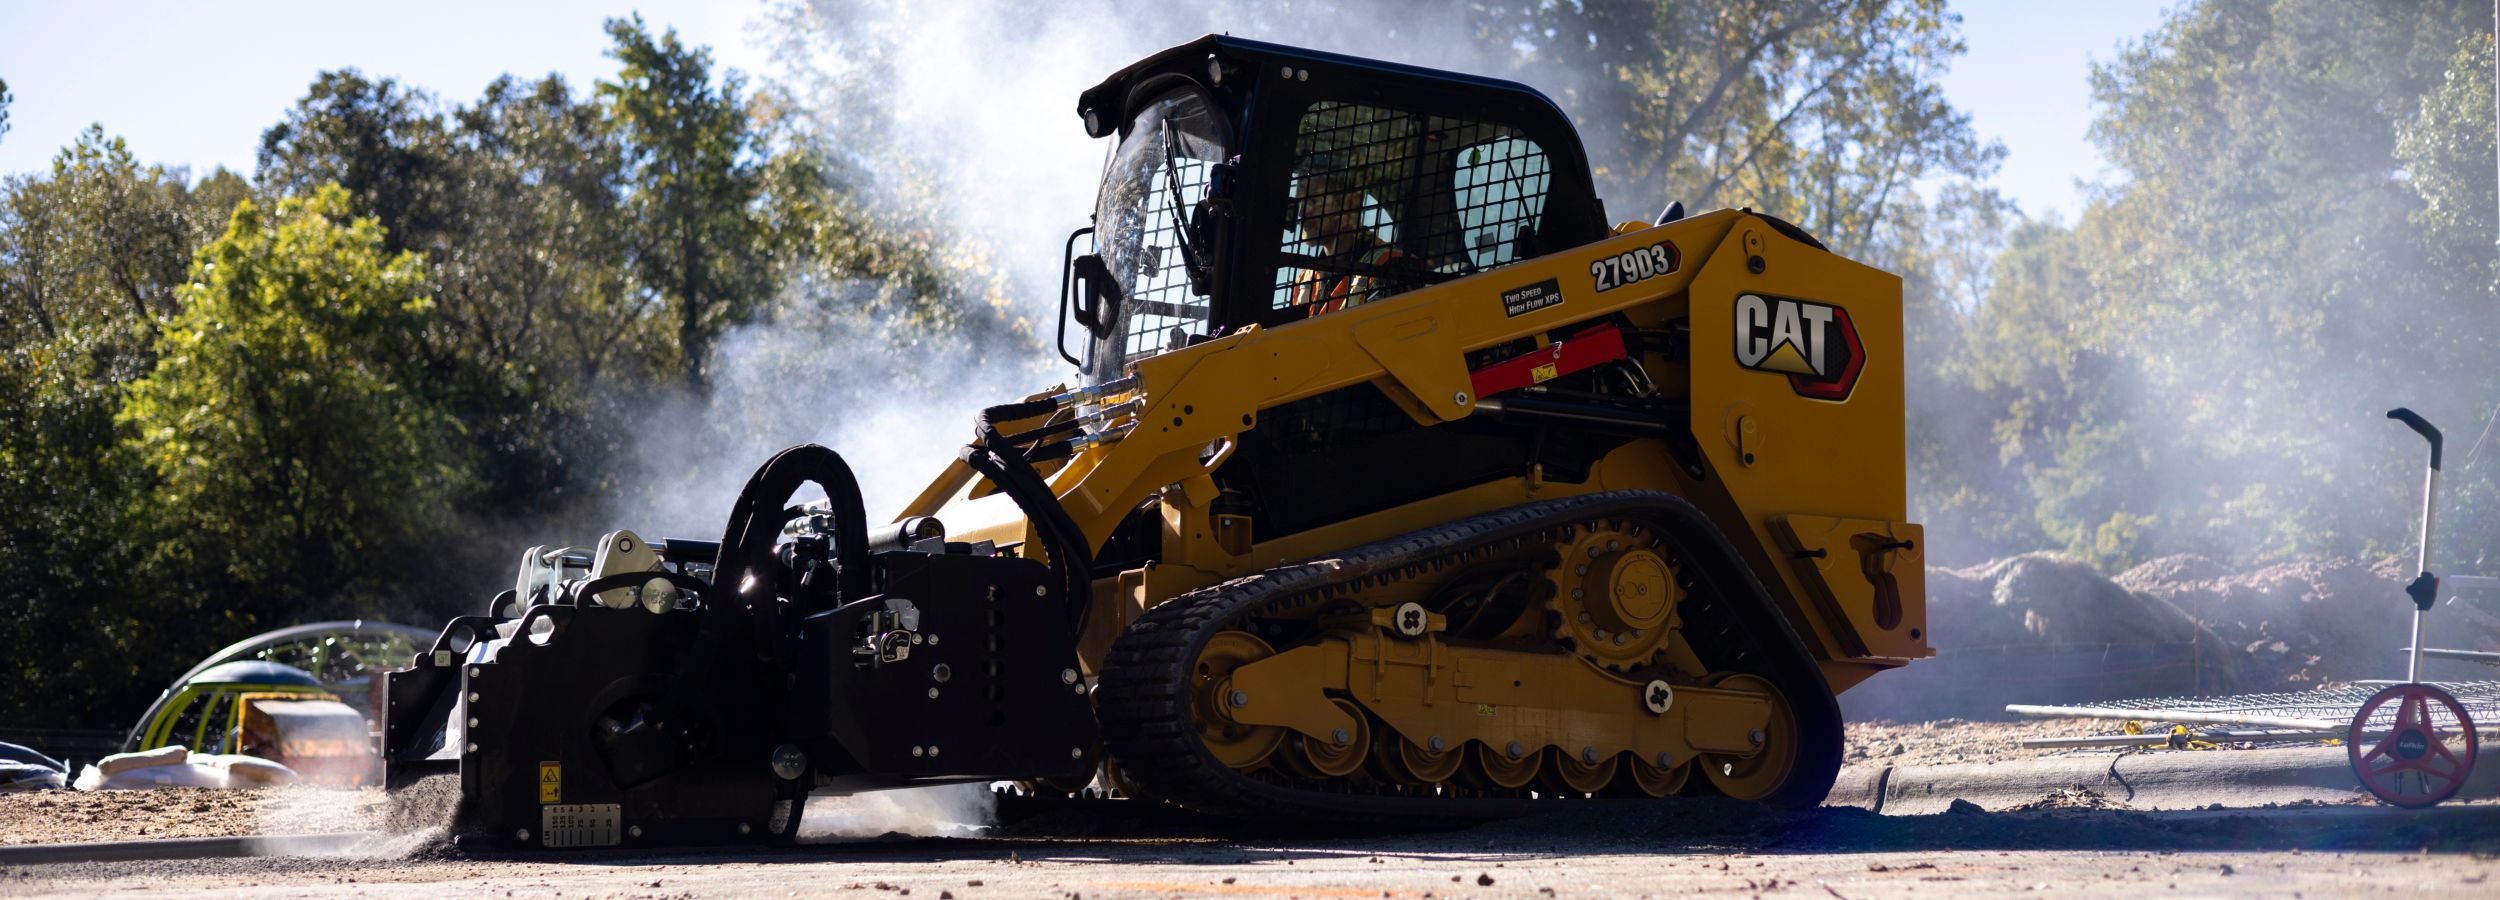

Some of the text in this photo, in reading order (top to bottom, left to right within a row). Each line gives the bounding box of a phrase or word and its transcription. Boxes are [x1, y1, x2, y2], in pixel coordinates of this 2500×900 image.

[1591, 244, 1669, 292] 279D3
[1545, 292, 1560, 305] XPS
[1736, 294, 1833, 376] CAT
[578, 819, 584, 828] 75
